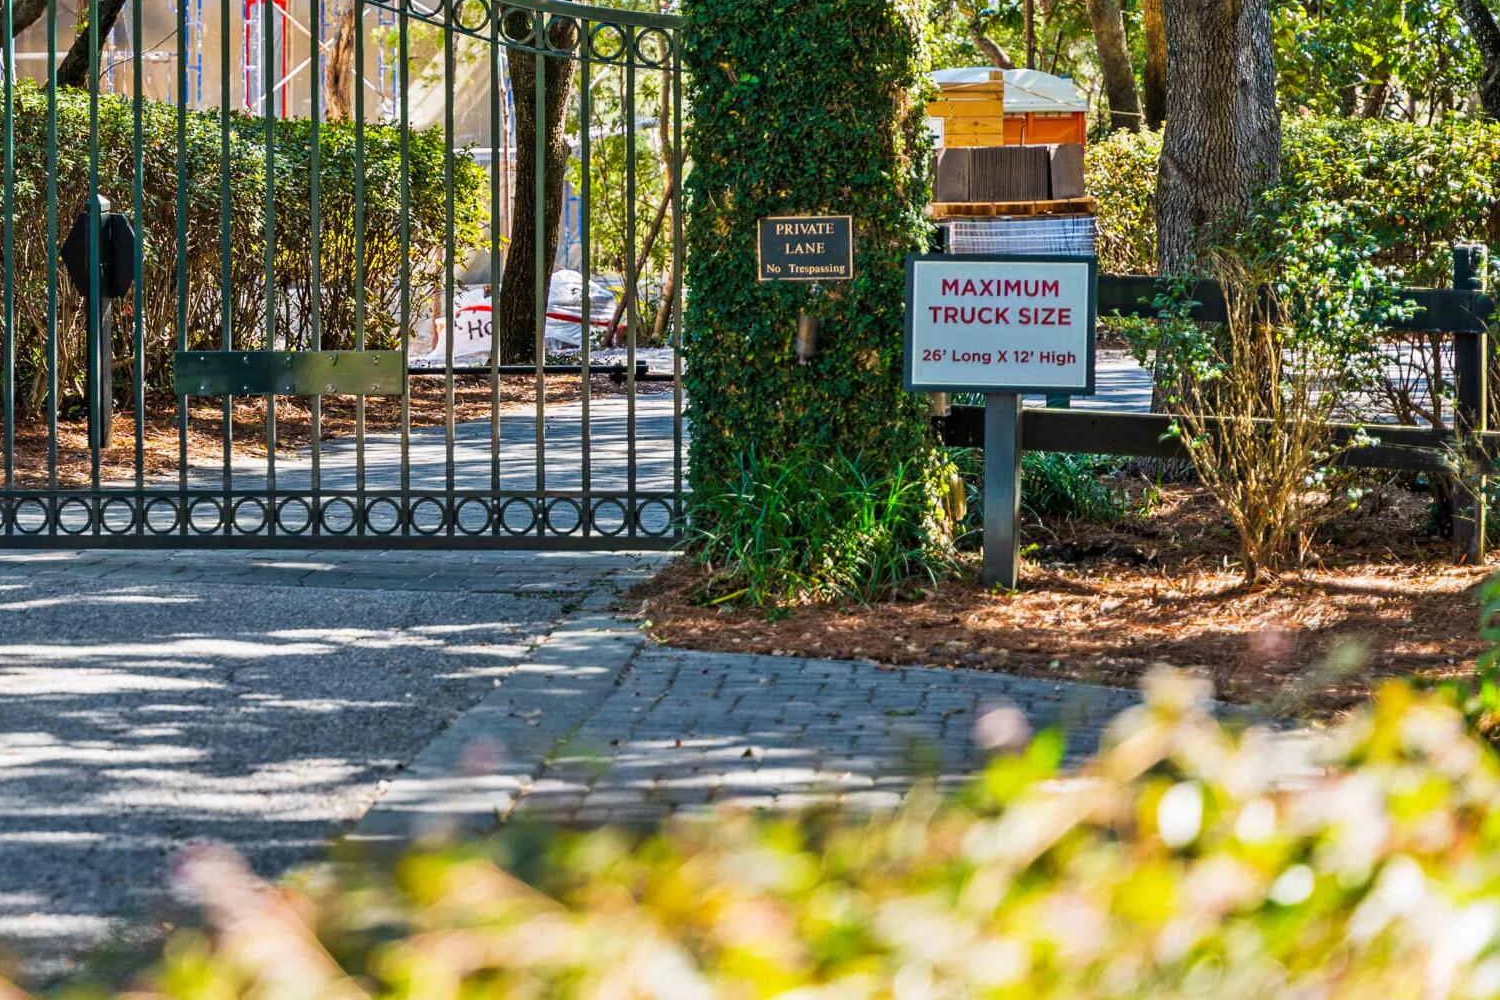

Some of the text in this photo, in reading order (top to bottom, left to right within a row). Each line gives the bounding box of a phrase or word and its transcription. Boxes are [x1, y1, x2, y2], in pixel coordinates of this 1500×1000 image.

[776, 222, 835, 235] PRIVATE
[785, 242, 826, 255] LANE
[766, 263, 846, 275] No Trespassing
[941, 278, 1060, 297] MAXIMUM
[928, 306, 1072, 326] TRUCK SIZE
[952, 349, 992, 365] Long
[997, 350, 1008, 363] X
[1039, 350, 1077, 366] High
